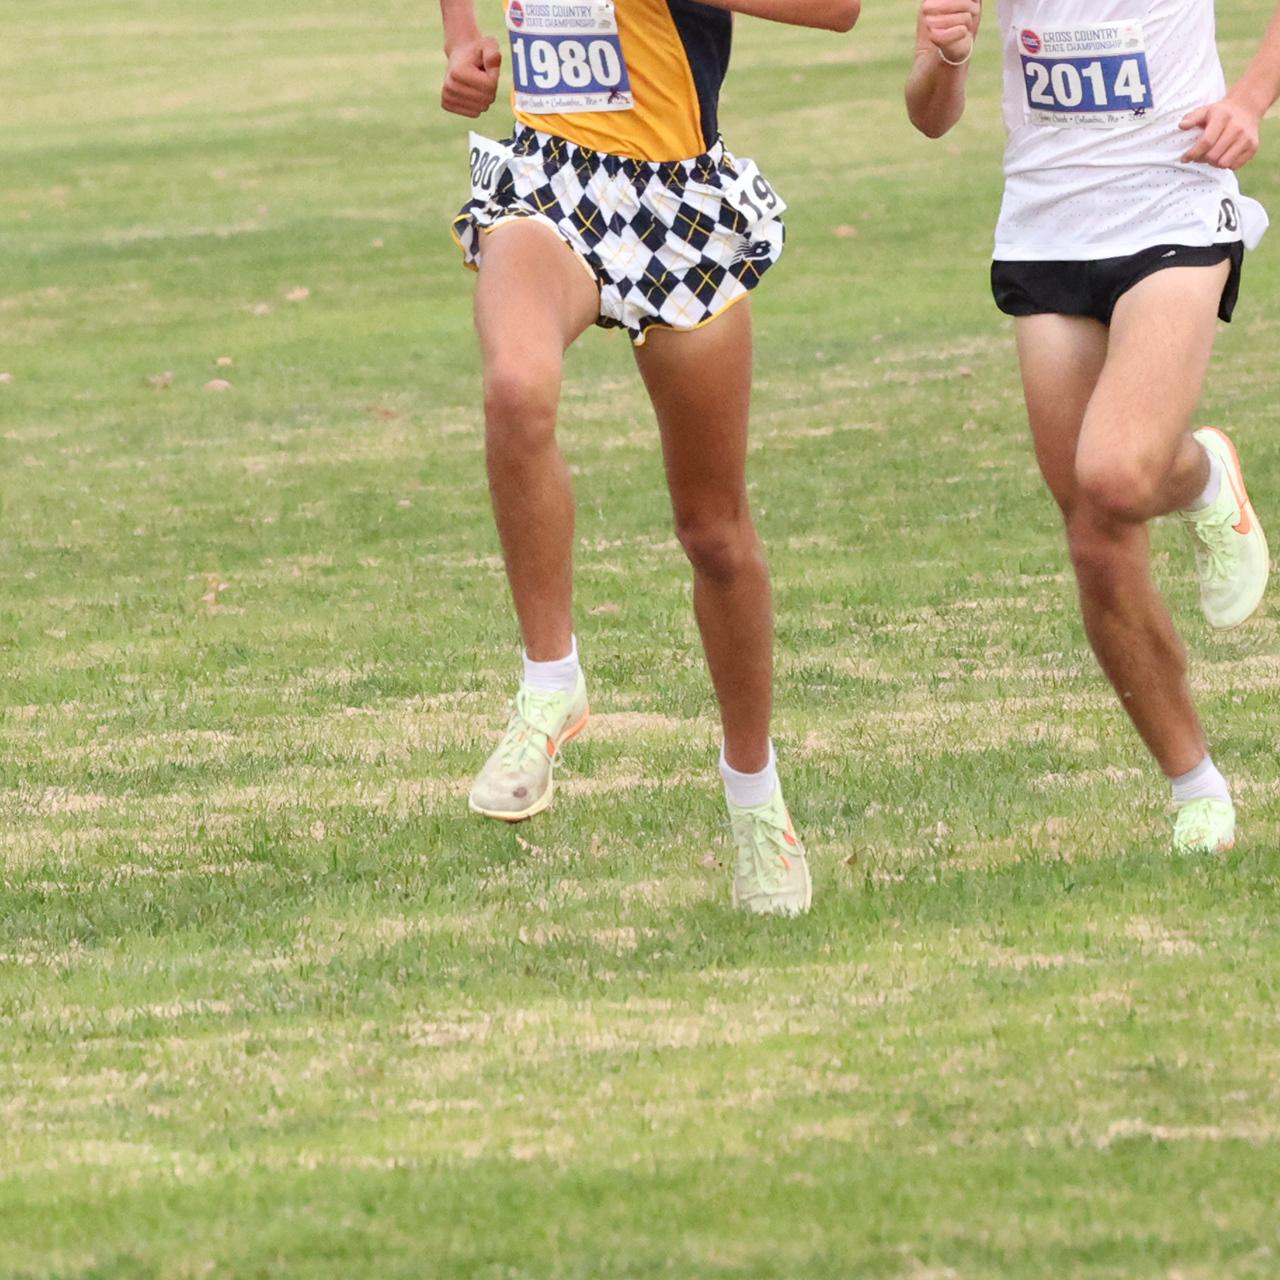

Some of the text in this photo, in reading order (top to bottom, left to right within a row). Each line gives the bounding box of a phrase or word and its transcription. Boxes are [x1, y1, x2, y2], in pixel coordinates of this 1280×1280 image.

[525, 4, 550, 16] CROSS
[552, 5, 592, 17] COUNTRY
[525, 18, 543, 27] STATE
[1043, 31, 1072, 43] CROSS
[1074, 27, 1119, 42] COUNTRY
[1043, 43, 1065, 52] STATE
[1066, 39, 1122, 52] CHAMPIONSHIP
[512, 38, 622, 89] 1980
[1025, 59, 1147, 108] 2014
[738, 174, 776, 221] 19
